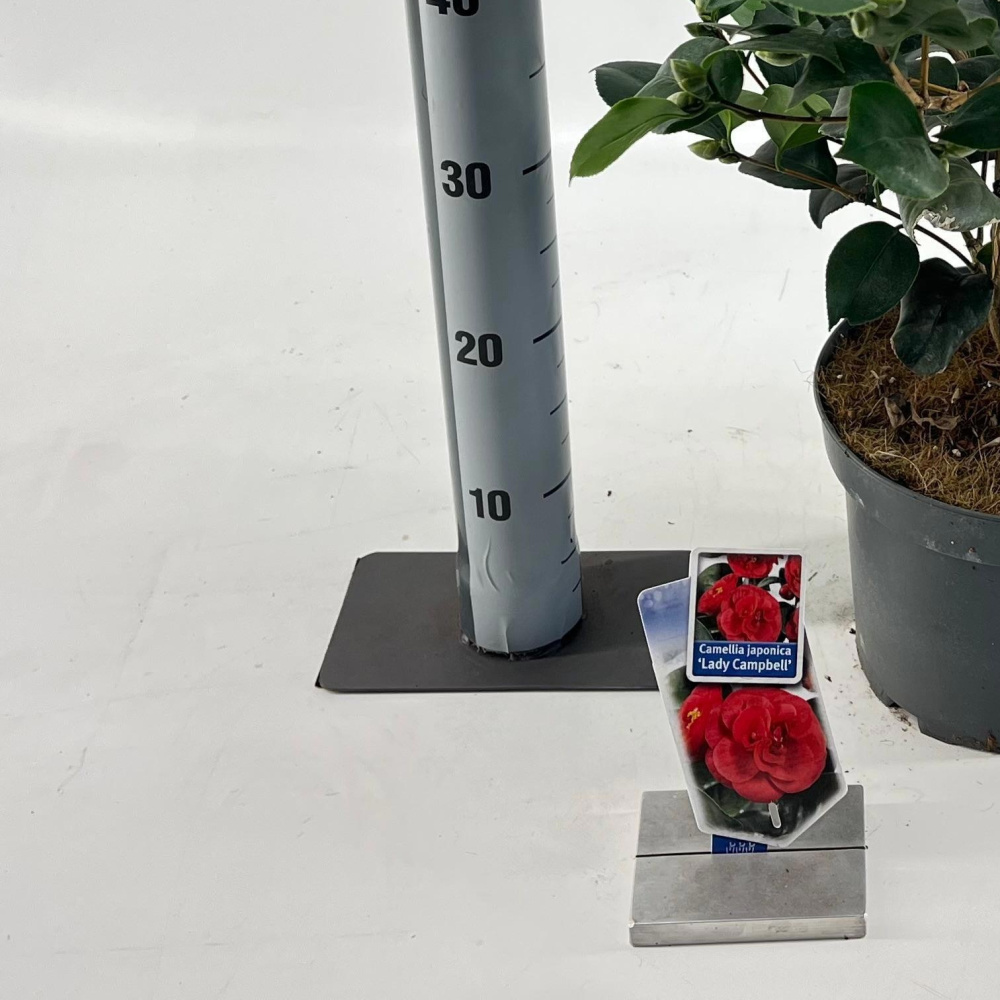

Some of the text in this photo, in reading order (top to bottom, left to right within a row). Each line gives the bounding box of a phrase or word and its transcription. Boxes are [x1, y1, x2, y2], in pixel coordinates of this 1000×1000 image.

[440, 160, 491, 199] 30
[454, 330, 503, 367] 20
[469, 487, 511, 521] 10
[698, 657, 792, 673] ‘Lady Campbell’
[699, 643, 792, 657] Camellia japonica
